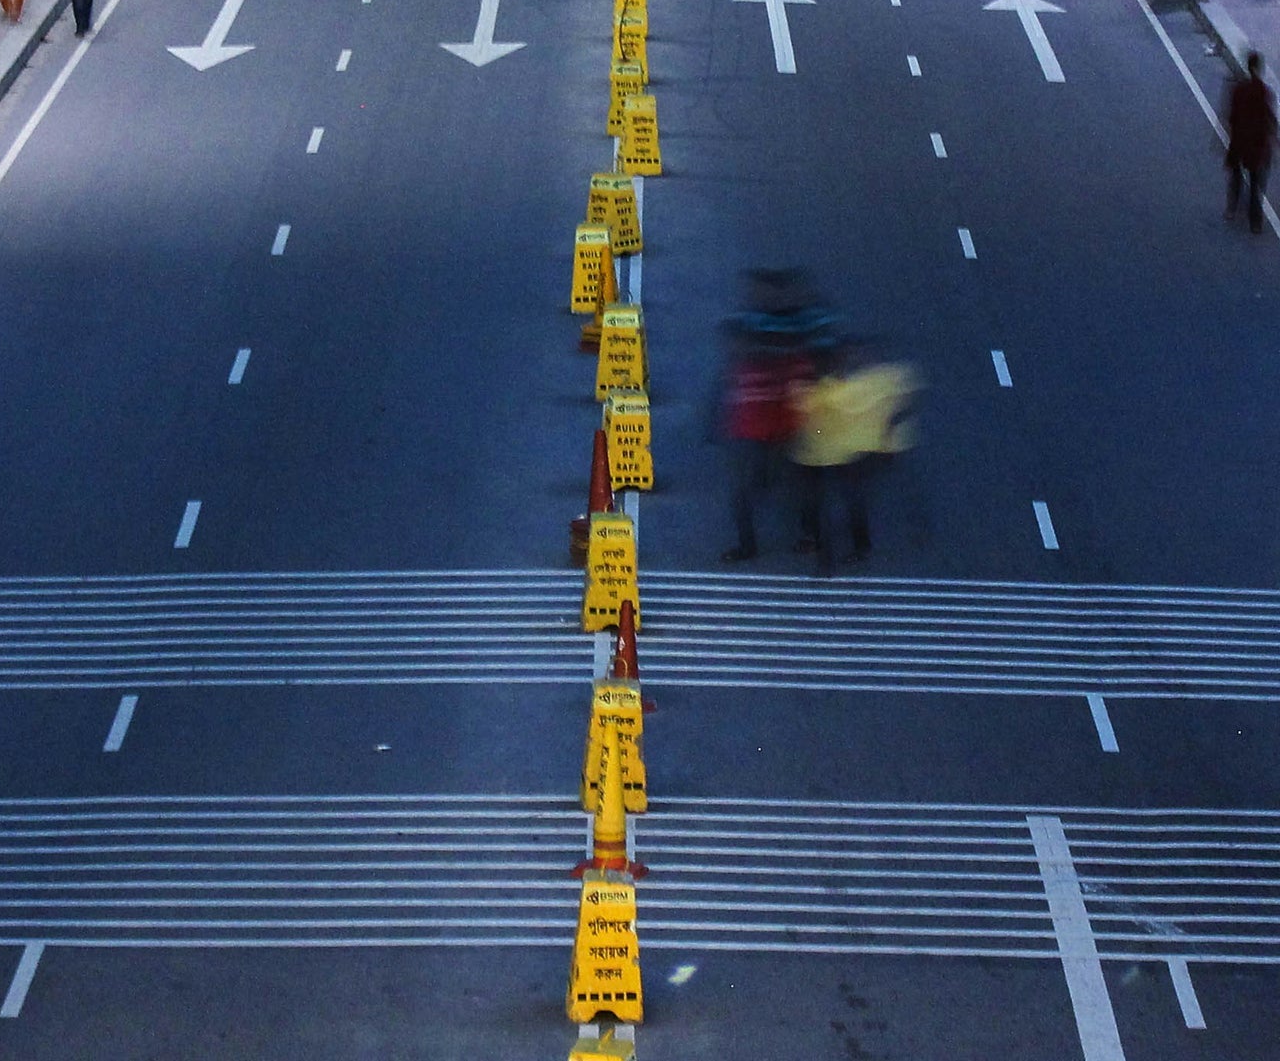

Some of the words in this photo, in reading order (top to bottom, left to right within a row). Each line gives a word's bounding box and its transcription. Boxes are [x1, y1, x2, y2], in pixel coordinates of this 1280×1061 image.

[616, 424, 644, 432] BUILD
[622, 450, 635, 458] BE
[616, 463, 639, 471] SAFE
[600, 892, 628, 900] BSRM
[588, 916, 631, 936] পুলিশকে
[590, 945, 629, 960] সহায়তা
